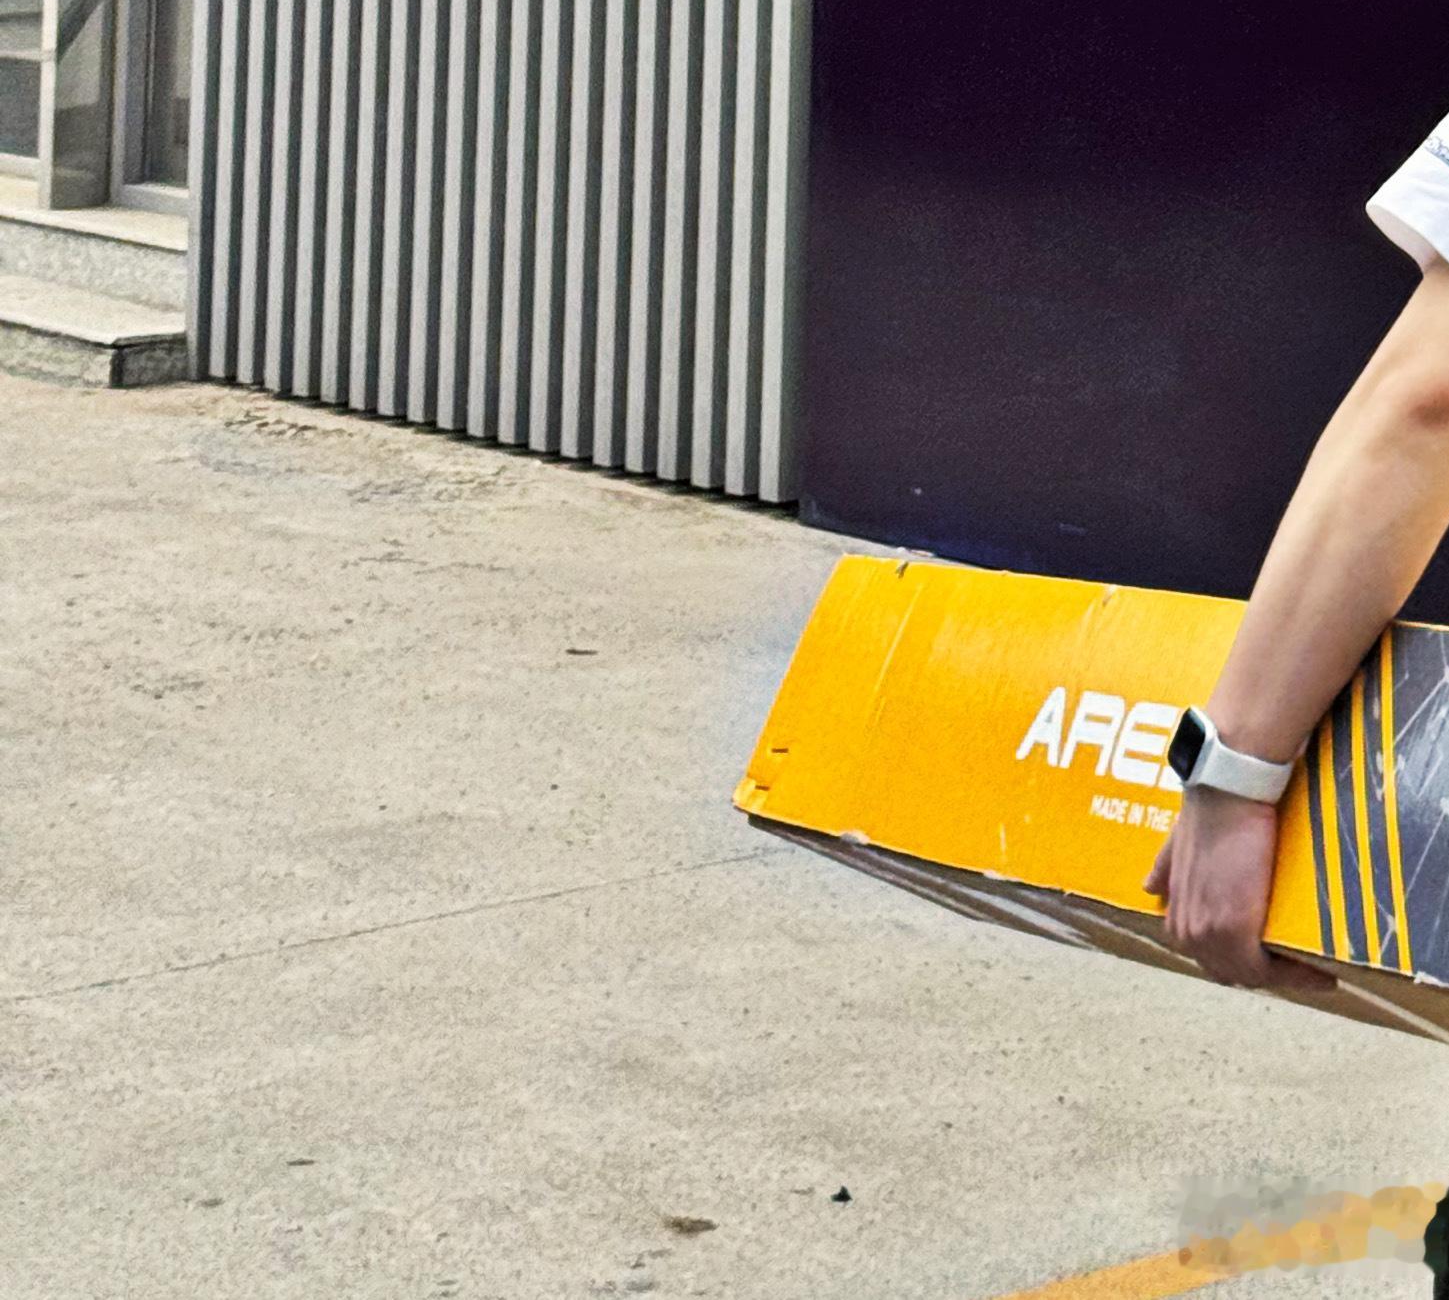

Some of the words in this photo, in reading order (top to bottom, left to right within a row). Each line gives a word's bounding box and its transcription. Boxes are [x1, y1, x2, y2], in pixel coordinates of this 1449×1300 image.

[1015, 686, 1184, 792] ARE
[1091, 795, 1129, 823] MADE
[1127, 802, 1145, 827] IN
[1145, 805, 1173, 832] THE
